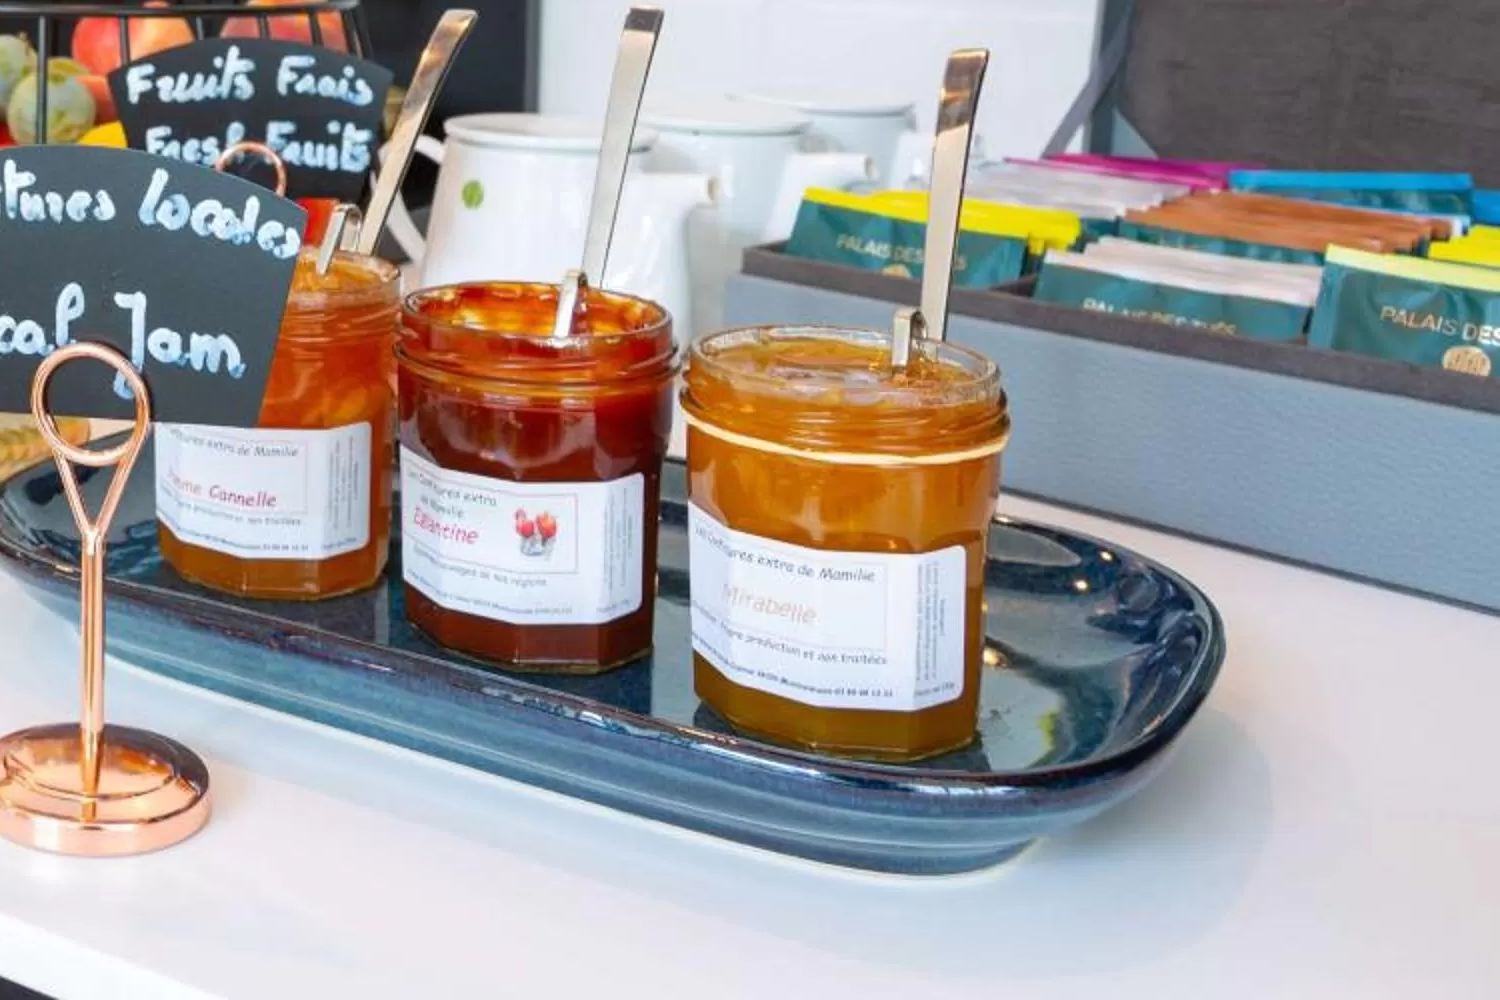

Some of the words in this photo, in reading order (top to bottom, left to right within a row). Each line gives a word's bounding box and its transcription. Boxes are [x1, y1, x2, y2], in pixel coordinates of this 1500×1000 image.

[126, 45, 255, 104] Fruits
[277, 55, 373, 106] Frais
[835, 233, 893, 260] PALAIS
[1380, 304, 1458, 337] PALAIS
[114, 290, 247, 400] Jam
[208, 483, 277, 508] Cannelle
[756, 555, 795, 574] extra
[797, 563, 815, 579] de
[720, 582, 819, 625] Mirabelle
